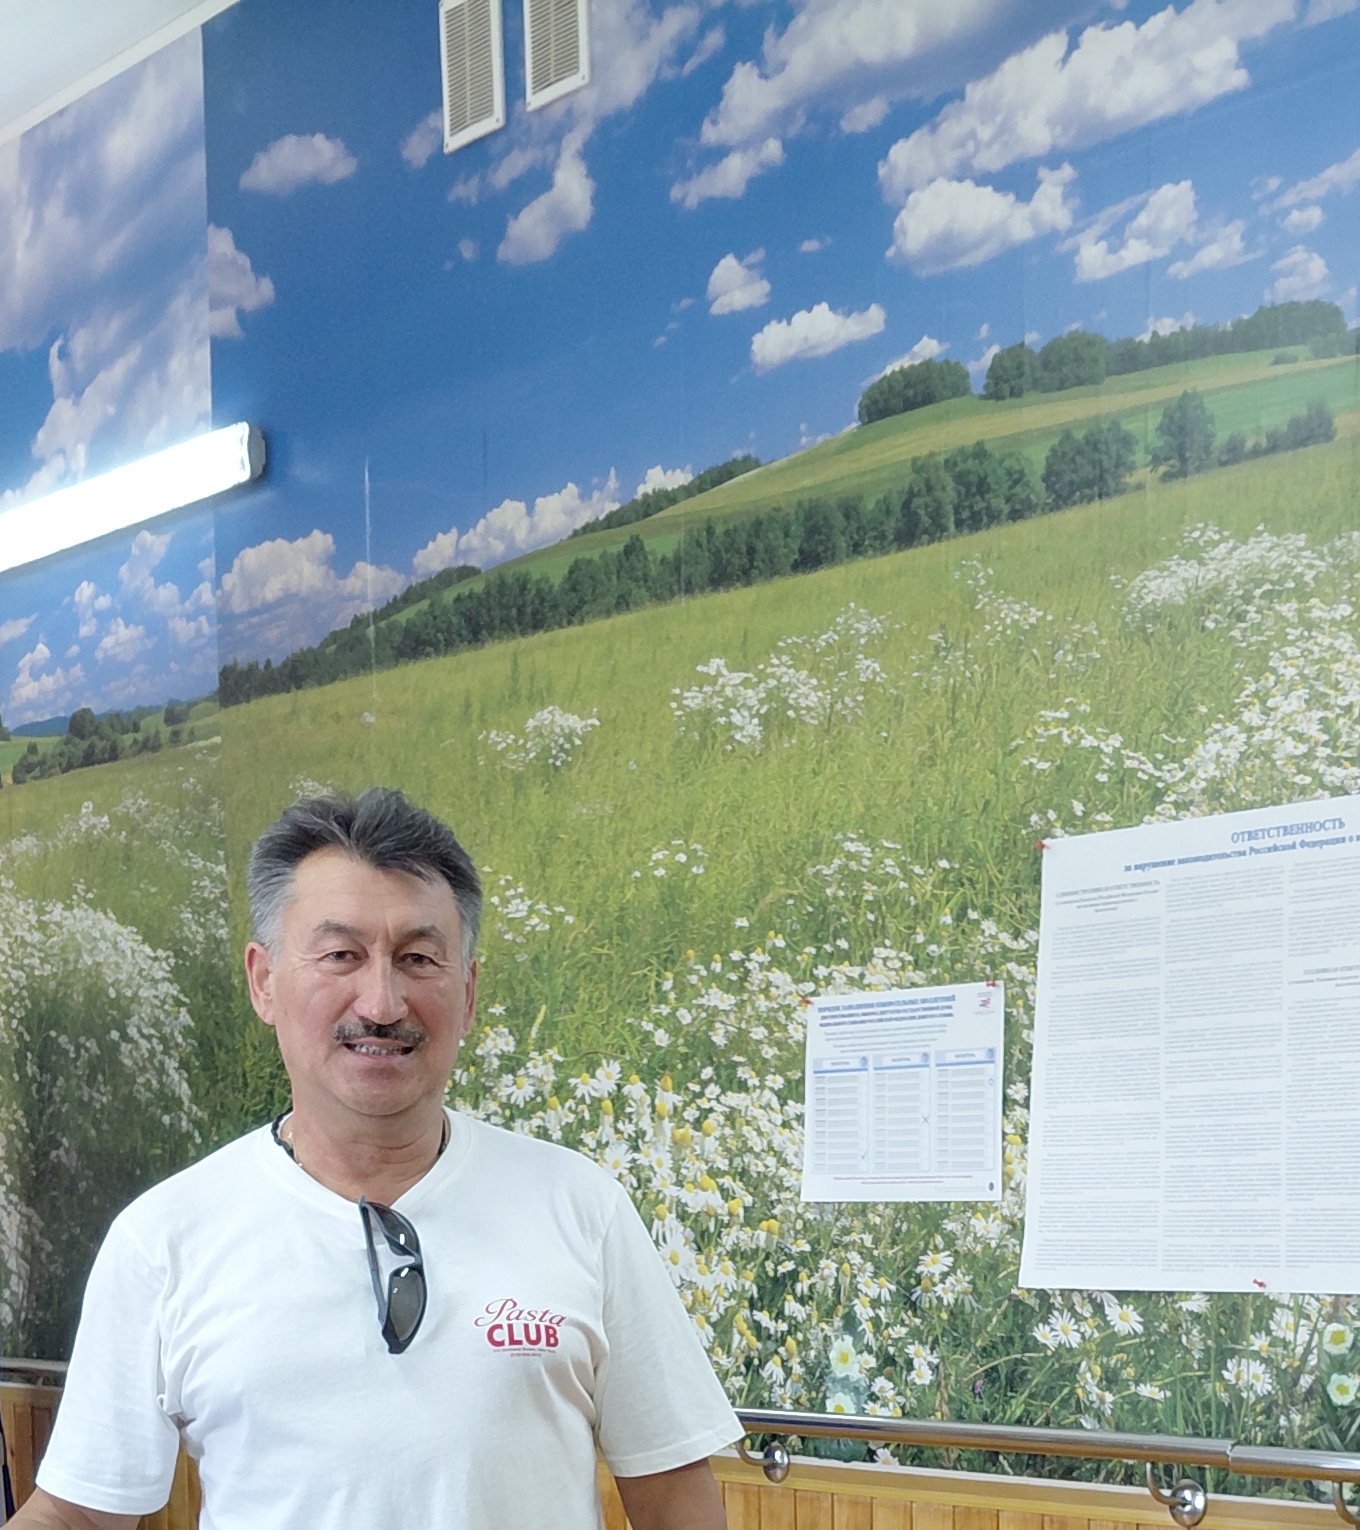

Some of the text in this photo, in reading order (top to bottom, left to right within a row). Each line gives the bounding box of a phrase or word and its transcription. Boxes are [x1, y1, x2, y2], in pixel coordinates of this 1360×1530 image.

[1230, 817, 1346, 844] ОТВЕТСТВЕННОСТЬ
[474, 1297, 567, 1328] Pasta
[486, 1323, 560, 1348] CLUB
